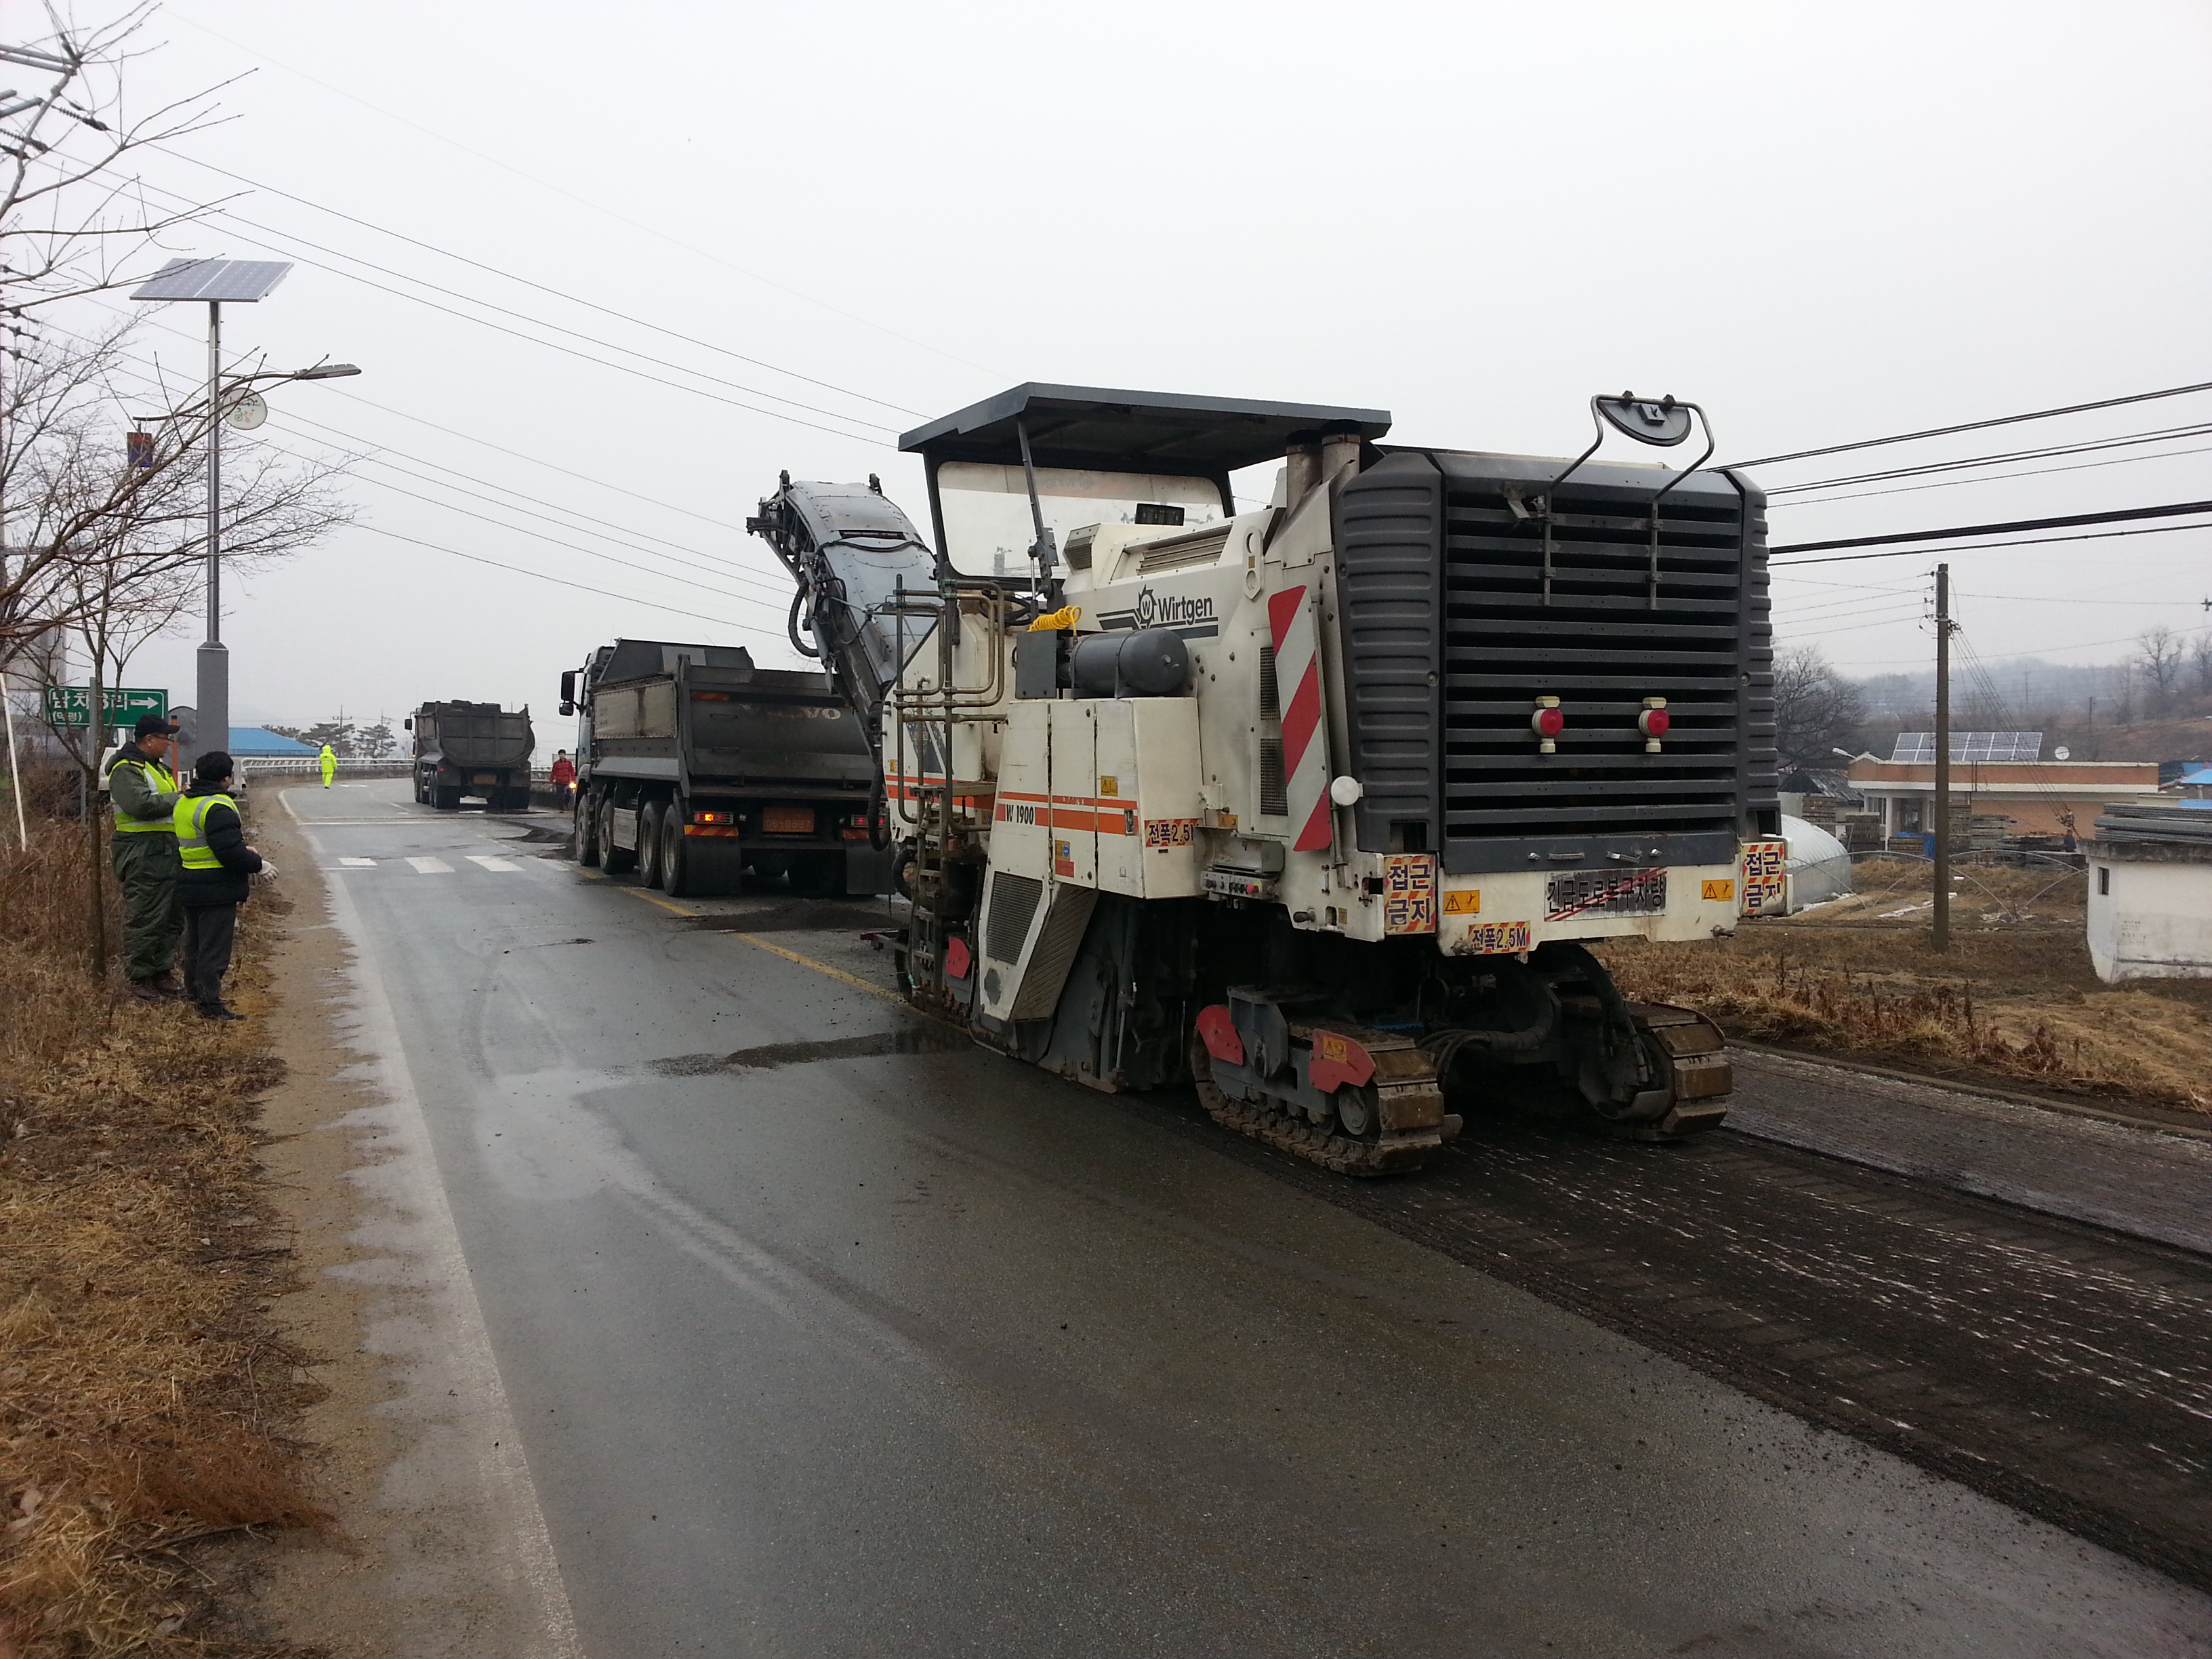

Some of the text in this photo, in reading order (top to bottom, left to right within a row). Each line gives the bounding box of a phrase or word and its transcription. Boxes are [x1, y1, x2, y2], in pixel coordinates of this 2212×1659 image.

[1158, 596, 1213, 625] Wirtgen
[1006, 804, 1034, 825] W 1900
[1149, 823, 1194, 844] 전폭2.5
[1389, 864, 1431, 890] 접근
[1746, 852, 1780, 876] 접근
[1547, 874, 1665, 913] 긴급도로복구차량
[1746, 882, 1780, 908] 금지
[1389, 898, 1431, 925] 금지
[1472, 927, 1526, 951] 전폭2.5M
